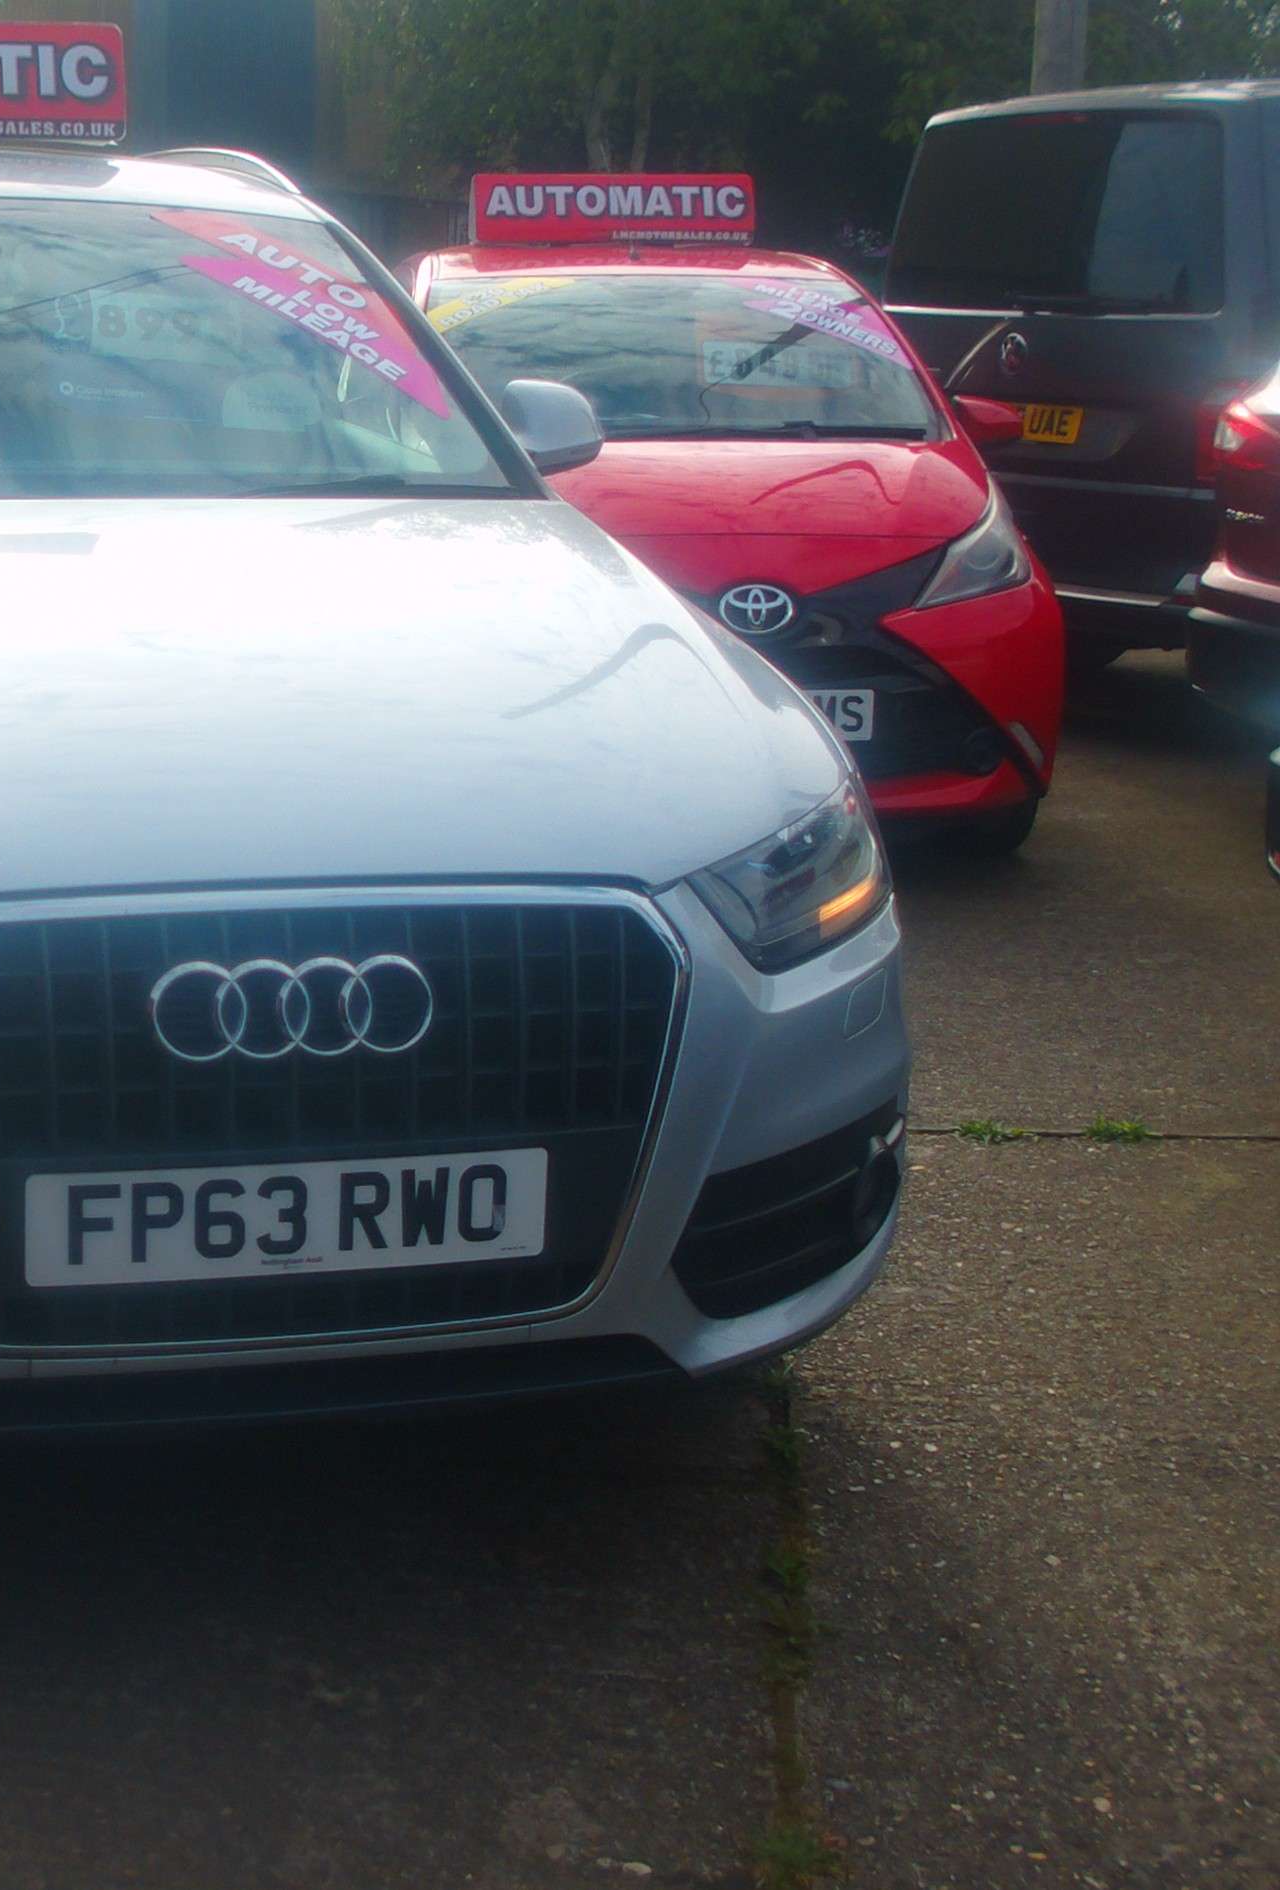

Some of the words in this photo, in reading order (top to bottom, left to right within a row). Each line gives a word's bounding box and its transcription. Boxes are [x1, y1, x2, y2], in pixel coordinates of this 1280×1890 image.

[486, 184, 746, 219] AUTOMATIC
[612, 230, 749, 241] LMCMOTORSALES.CO.UK
[216, 233, 367, 309] AUTO
[231, 275, 408, 381] MILEAGE
[291, 289, 381, 341] LOW
[753, 284, 863, 323] MILEAGE
[770, 301, 803, 319] 2
[801, 311, 897, 354] OWNERS
[1029, 407, 1075, 437] UAE
[66, 1175, 309, 1266] FP63
[338, 1163, 508, 1251] RWO
